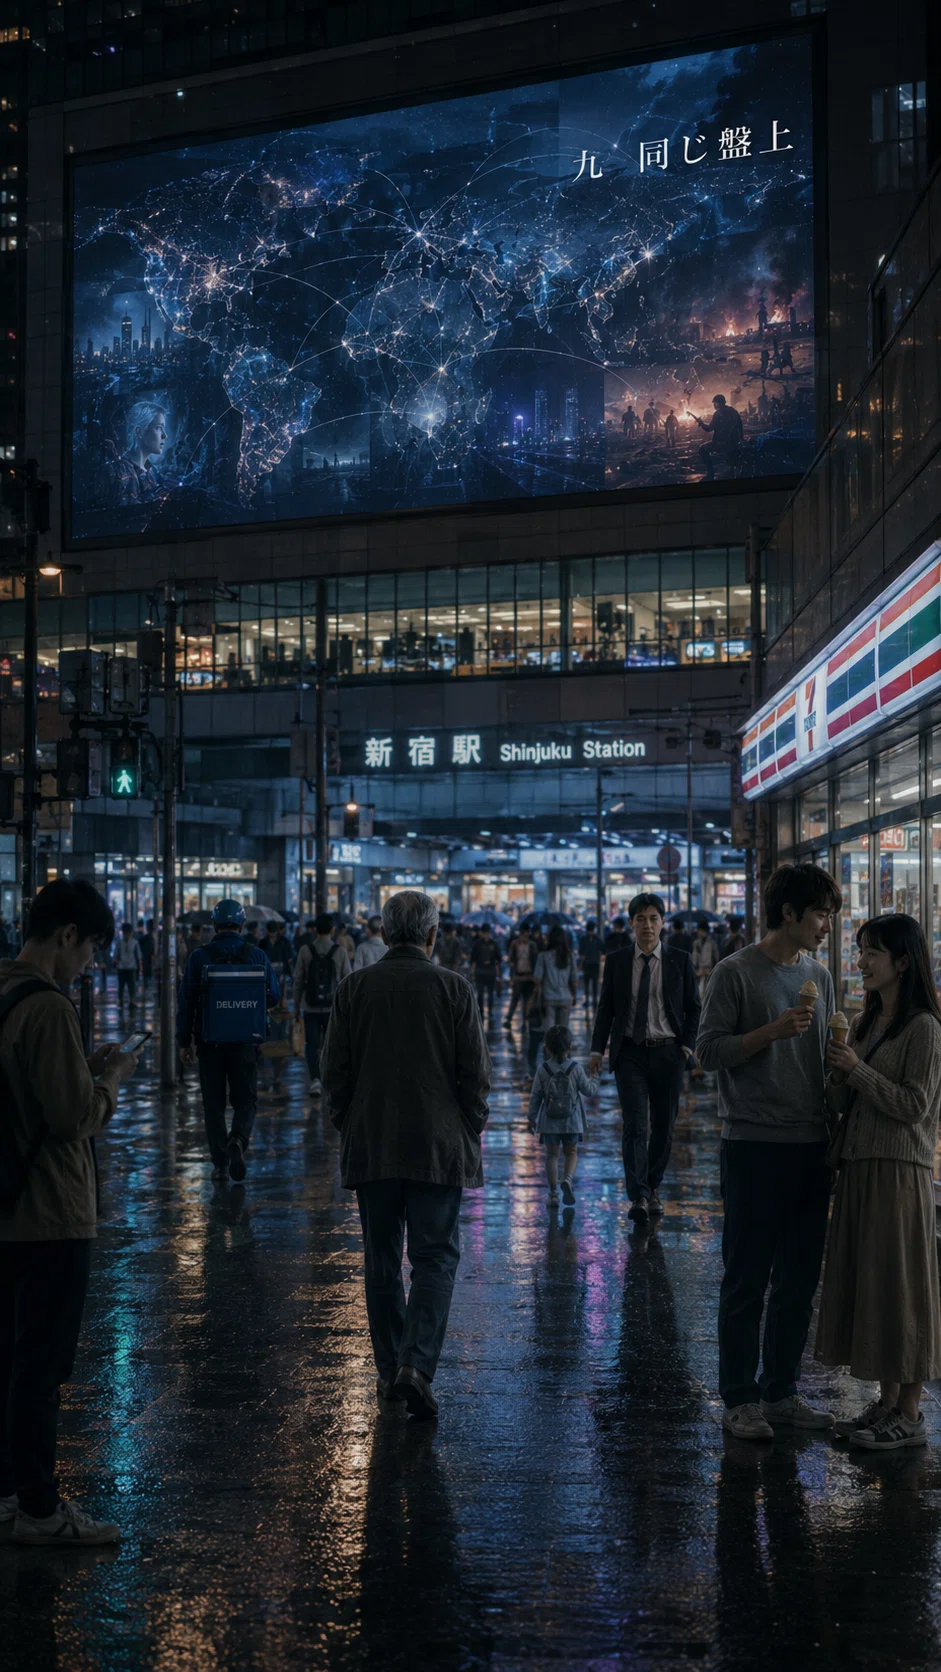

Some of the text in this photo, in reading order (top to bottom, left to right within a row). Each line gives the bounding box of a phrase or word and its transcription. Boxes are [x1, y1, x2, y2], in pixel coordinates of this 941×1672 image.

[572, 119, 794, 183] 九 同じ盤上
[365, 734, 646, 768] 新宿駅 Shinjuku Station
[216, 1000, 258, 1009] DELIVERY
